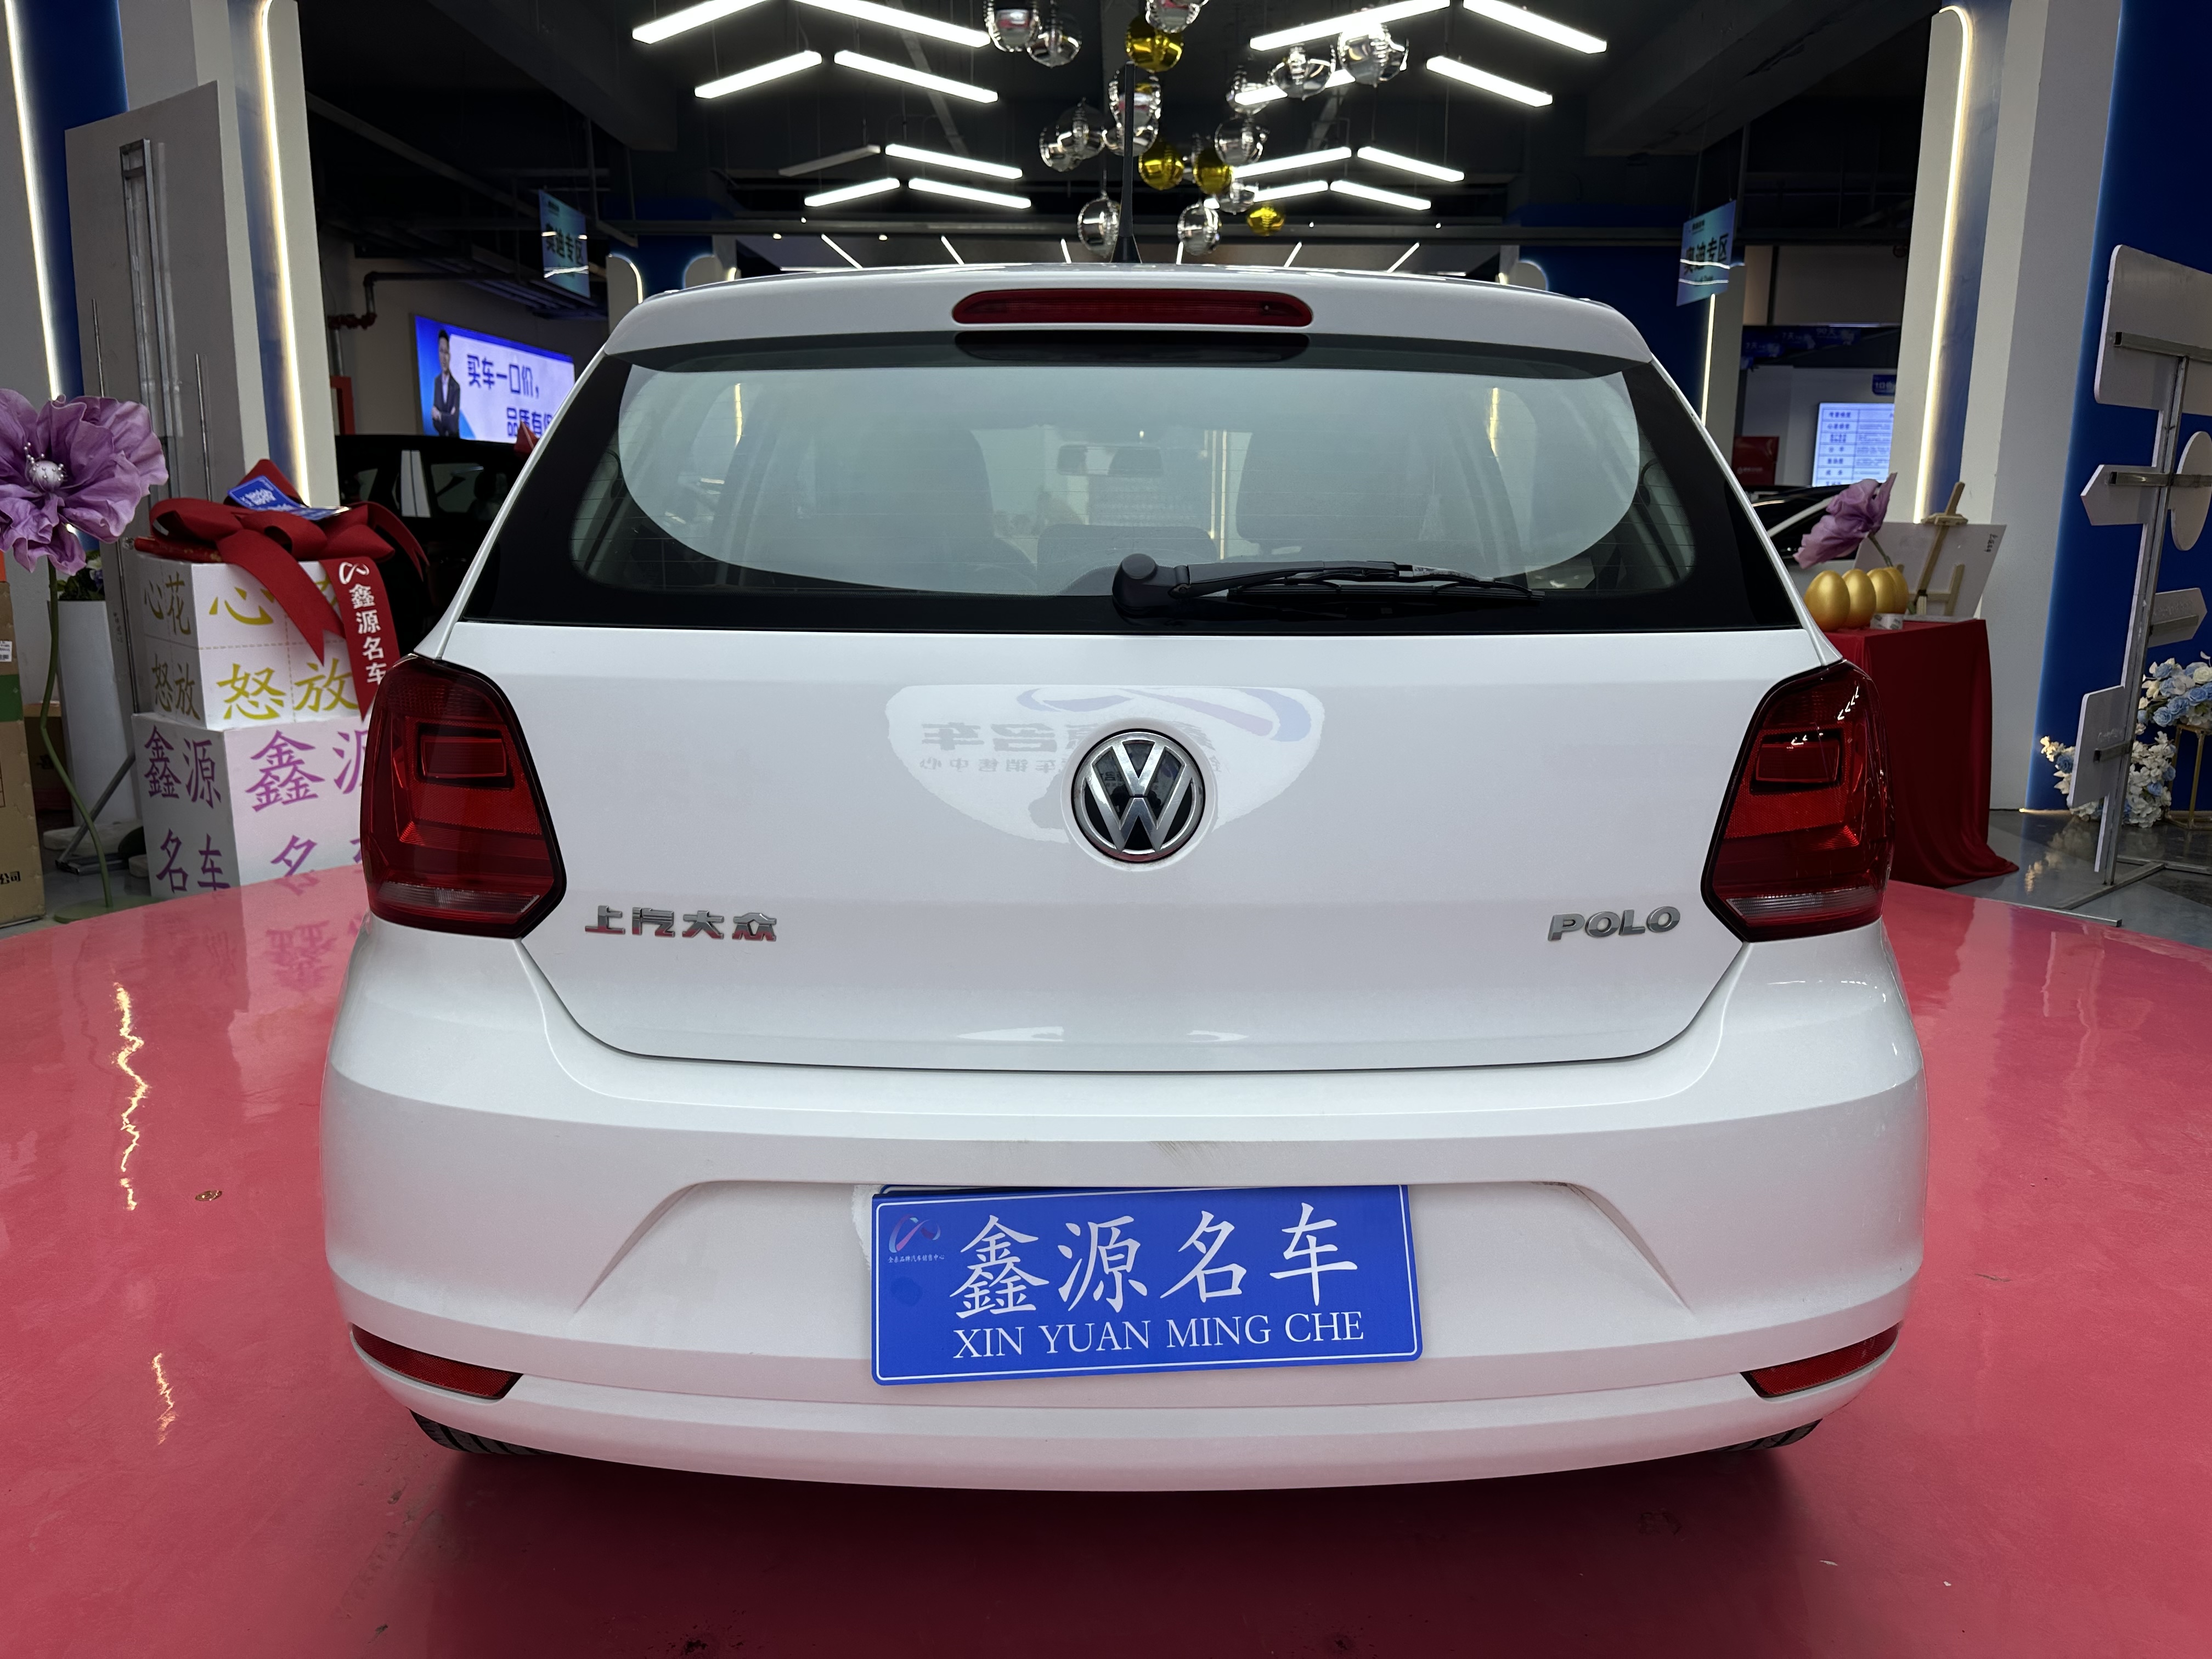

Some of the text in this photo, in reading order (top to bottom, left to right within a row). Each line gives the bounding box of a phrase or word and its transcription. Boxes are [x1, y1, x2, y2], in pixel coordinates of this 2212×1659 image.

[144, 571, 191, 635] 心花
[349, 583, 386, 686] 鑫源名车
[151, 653, 201, 720] 怒放
[217, 658, 359, 720] 怒放
[144, 725, 222, 809] 鑫源
[156, 828, 231, 894] 名车
[585, 905, 777, 942] 上汽大众
[1548, 906, 1680, 941] POLO
[949, 1202, 1358, 1319] 鑫源名车
[953, 1311, 1364, 1358] XIN YUAN MING CHE
